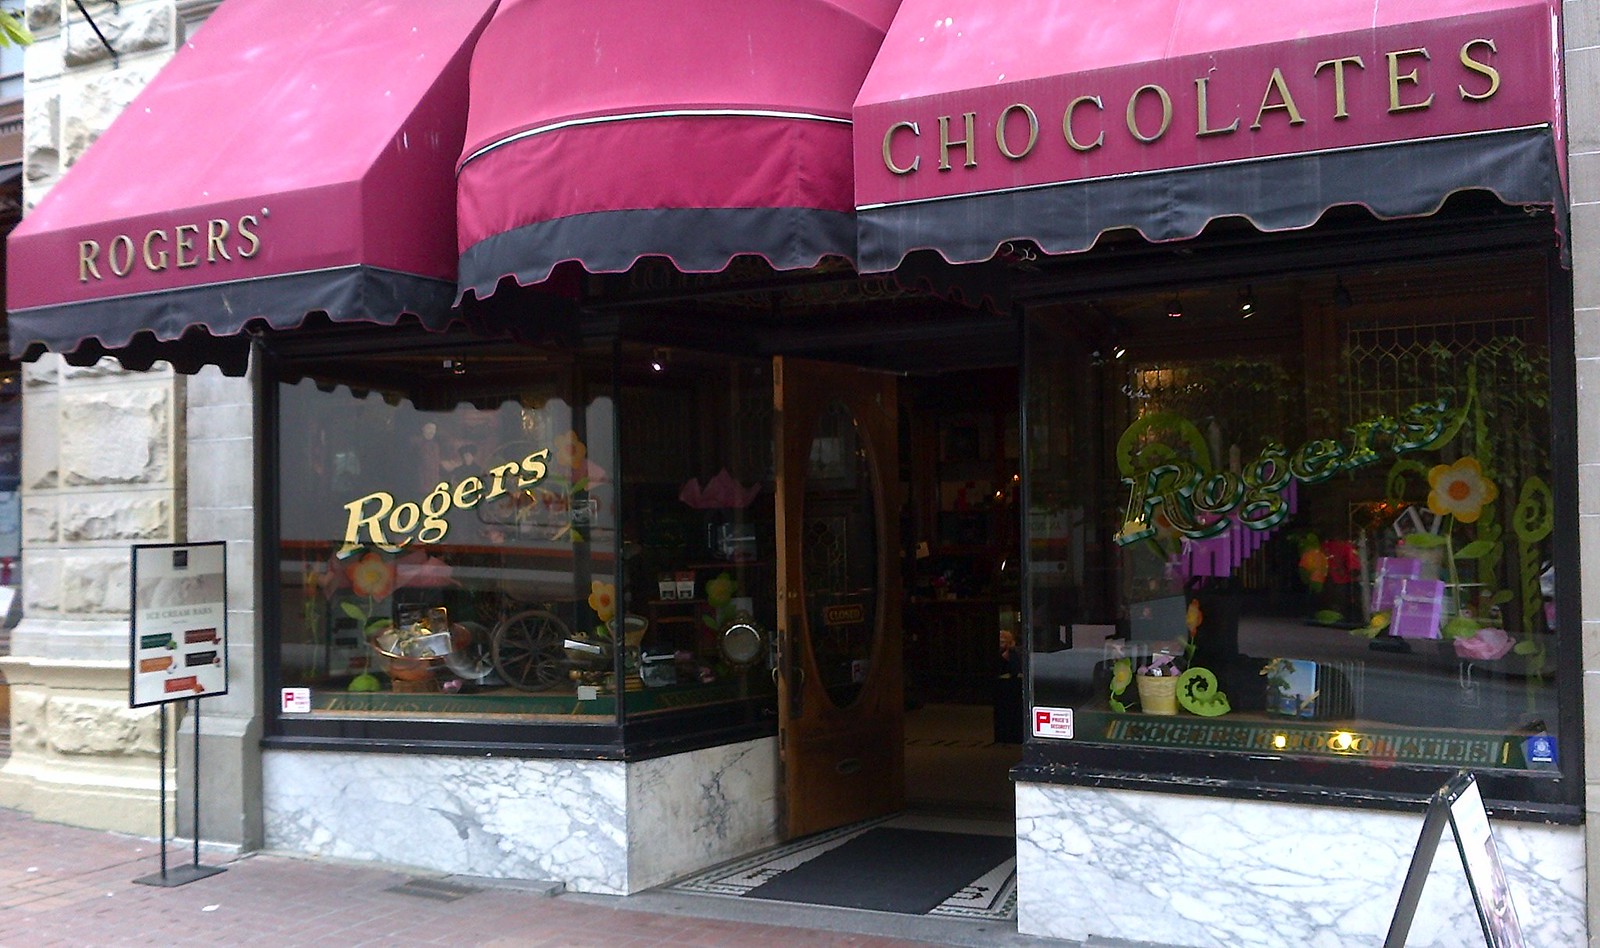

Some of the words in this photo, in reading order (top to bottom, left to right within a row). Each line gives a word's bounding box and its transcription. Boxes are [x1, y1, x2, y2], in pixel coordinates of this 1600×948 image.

[882, 38, 1501, 174] CHOCOLATES
[336, 448, 550, 561] Rogers
[1112, 398, 1448, 547] Rogers
[146, 611, 160, 620] ICE
[161, 608, 191, 618] CREAM
[193, 606, 213, 615] BARS
[1122, 720, 1249, 746] ROGERS
